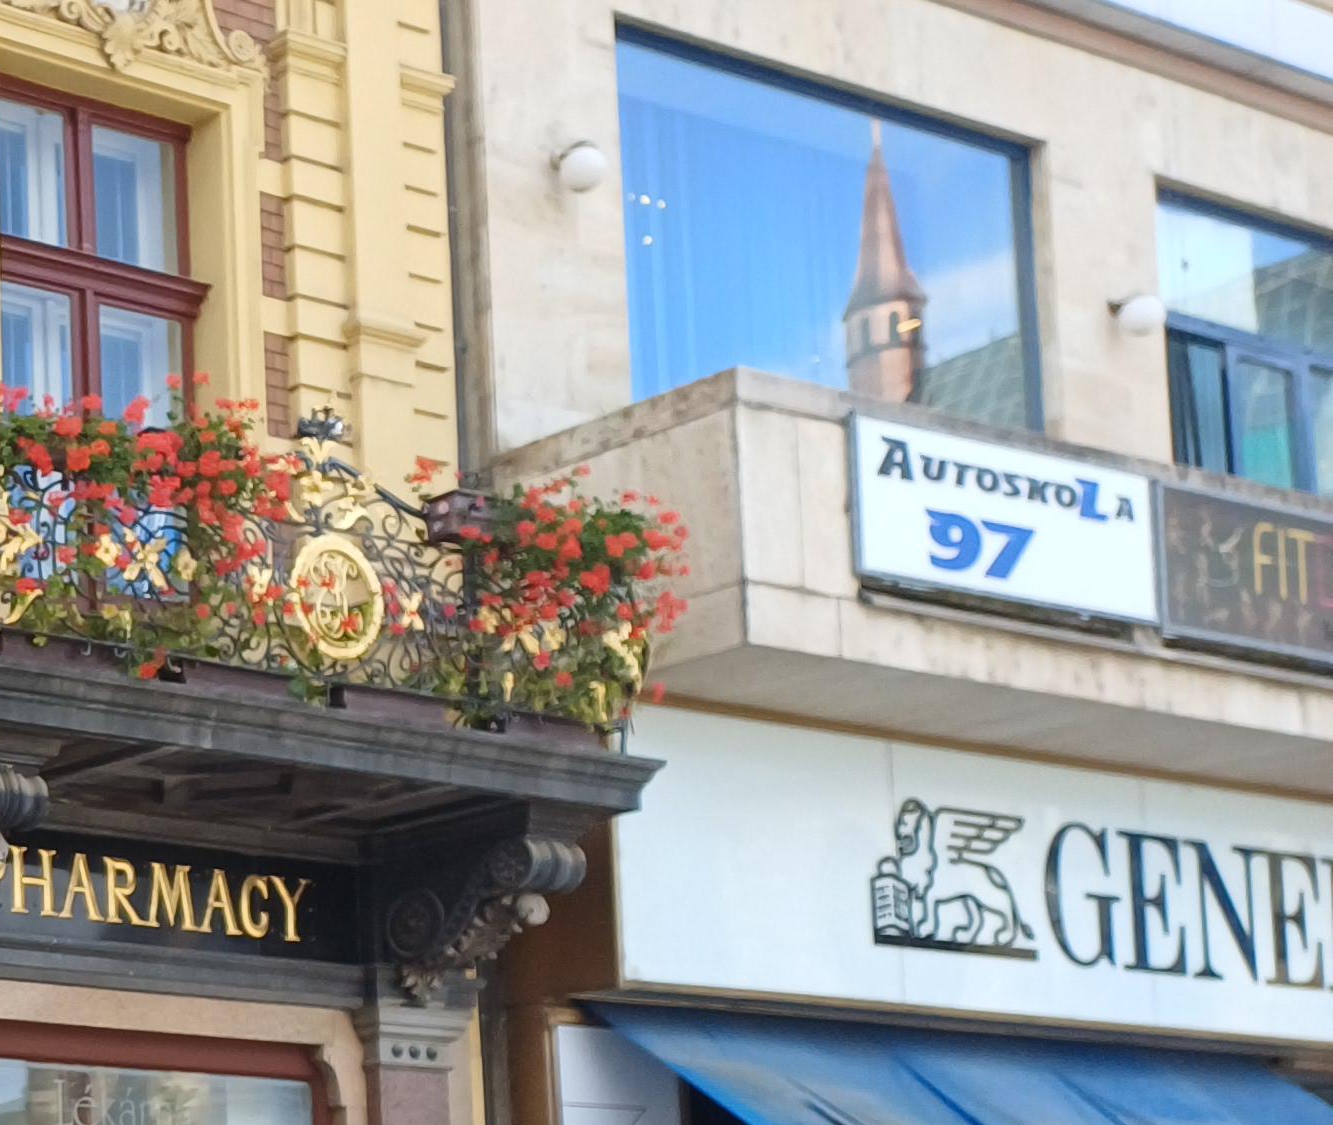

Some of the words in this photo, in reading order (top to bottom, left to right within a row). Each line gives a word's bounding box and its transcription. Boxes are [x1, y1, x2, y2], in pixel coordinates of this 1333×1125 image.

[924, 507, 1037, 580] 97
[1252, 521, 1333, 609] FIT
[1043, 820, 1333, 992] GENE
